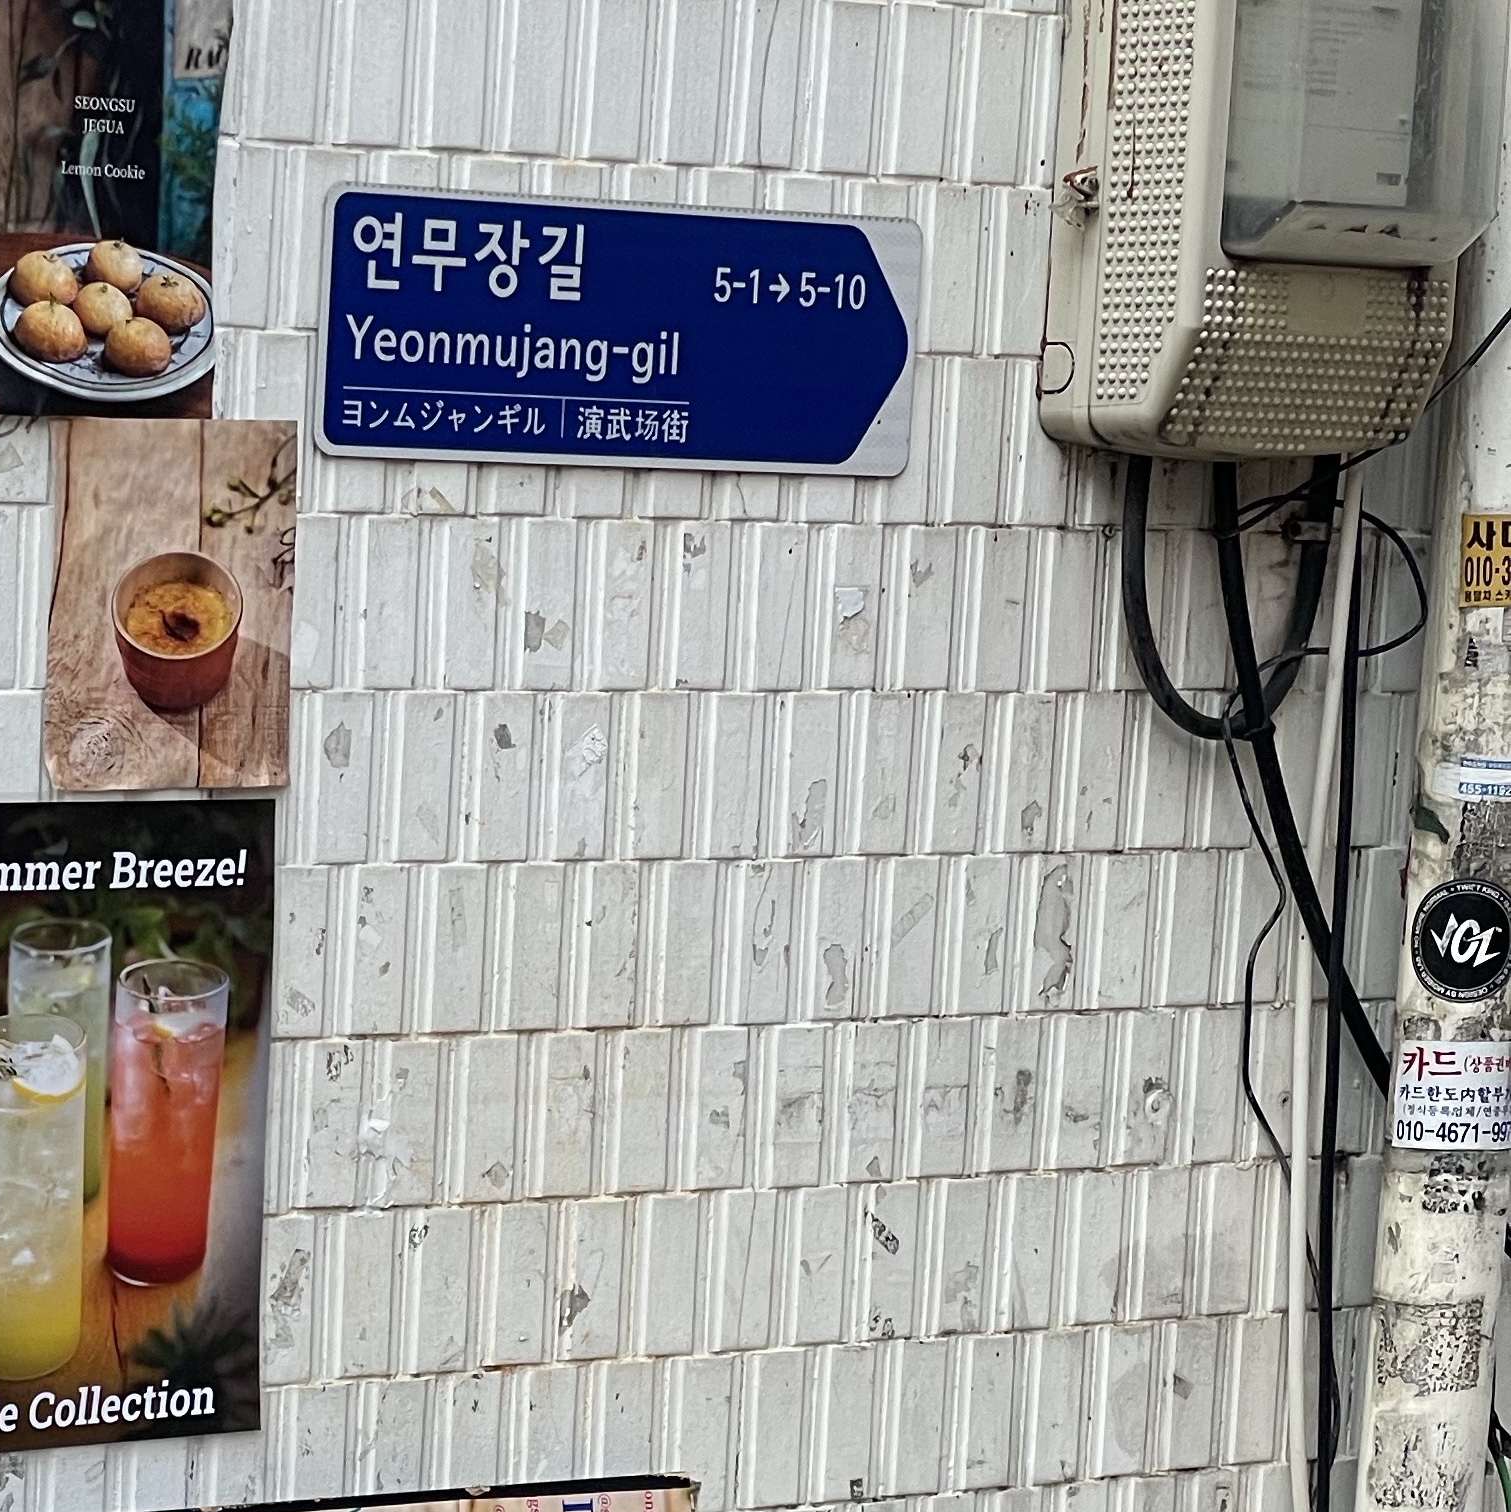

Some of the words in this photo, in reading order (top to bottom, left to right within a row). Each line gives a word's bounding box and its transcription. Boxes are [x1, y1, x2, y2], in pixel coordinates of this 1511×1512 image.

[74, 95, 136, 113] SEONGSU
[82, 118, 125, 135] JEGUA
[61, 160, 102, 177] Lemon
[104, 164, 146, 180] Cookie
[352, 211, 586, 301] 연무장길
[345, 313, 681, 383] Yeonmujang-gil
[342, 400, 545, 435] ヨンムジャンギル
[109, 849, 248, 889] Breeze!
[1402, 1046, 1462, 1082] 카드
[27, 1380, 216, 1432] Collection
